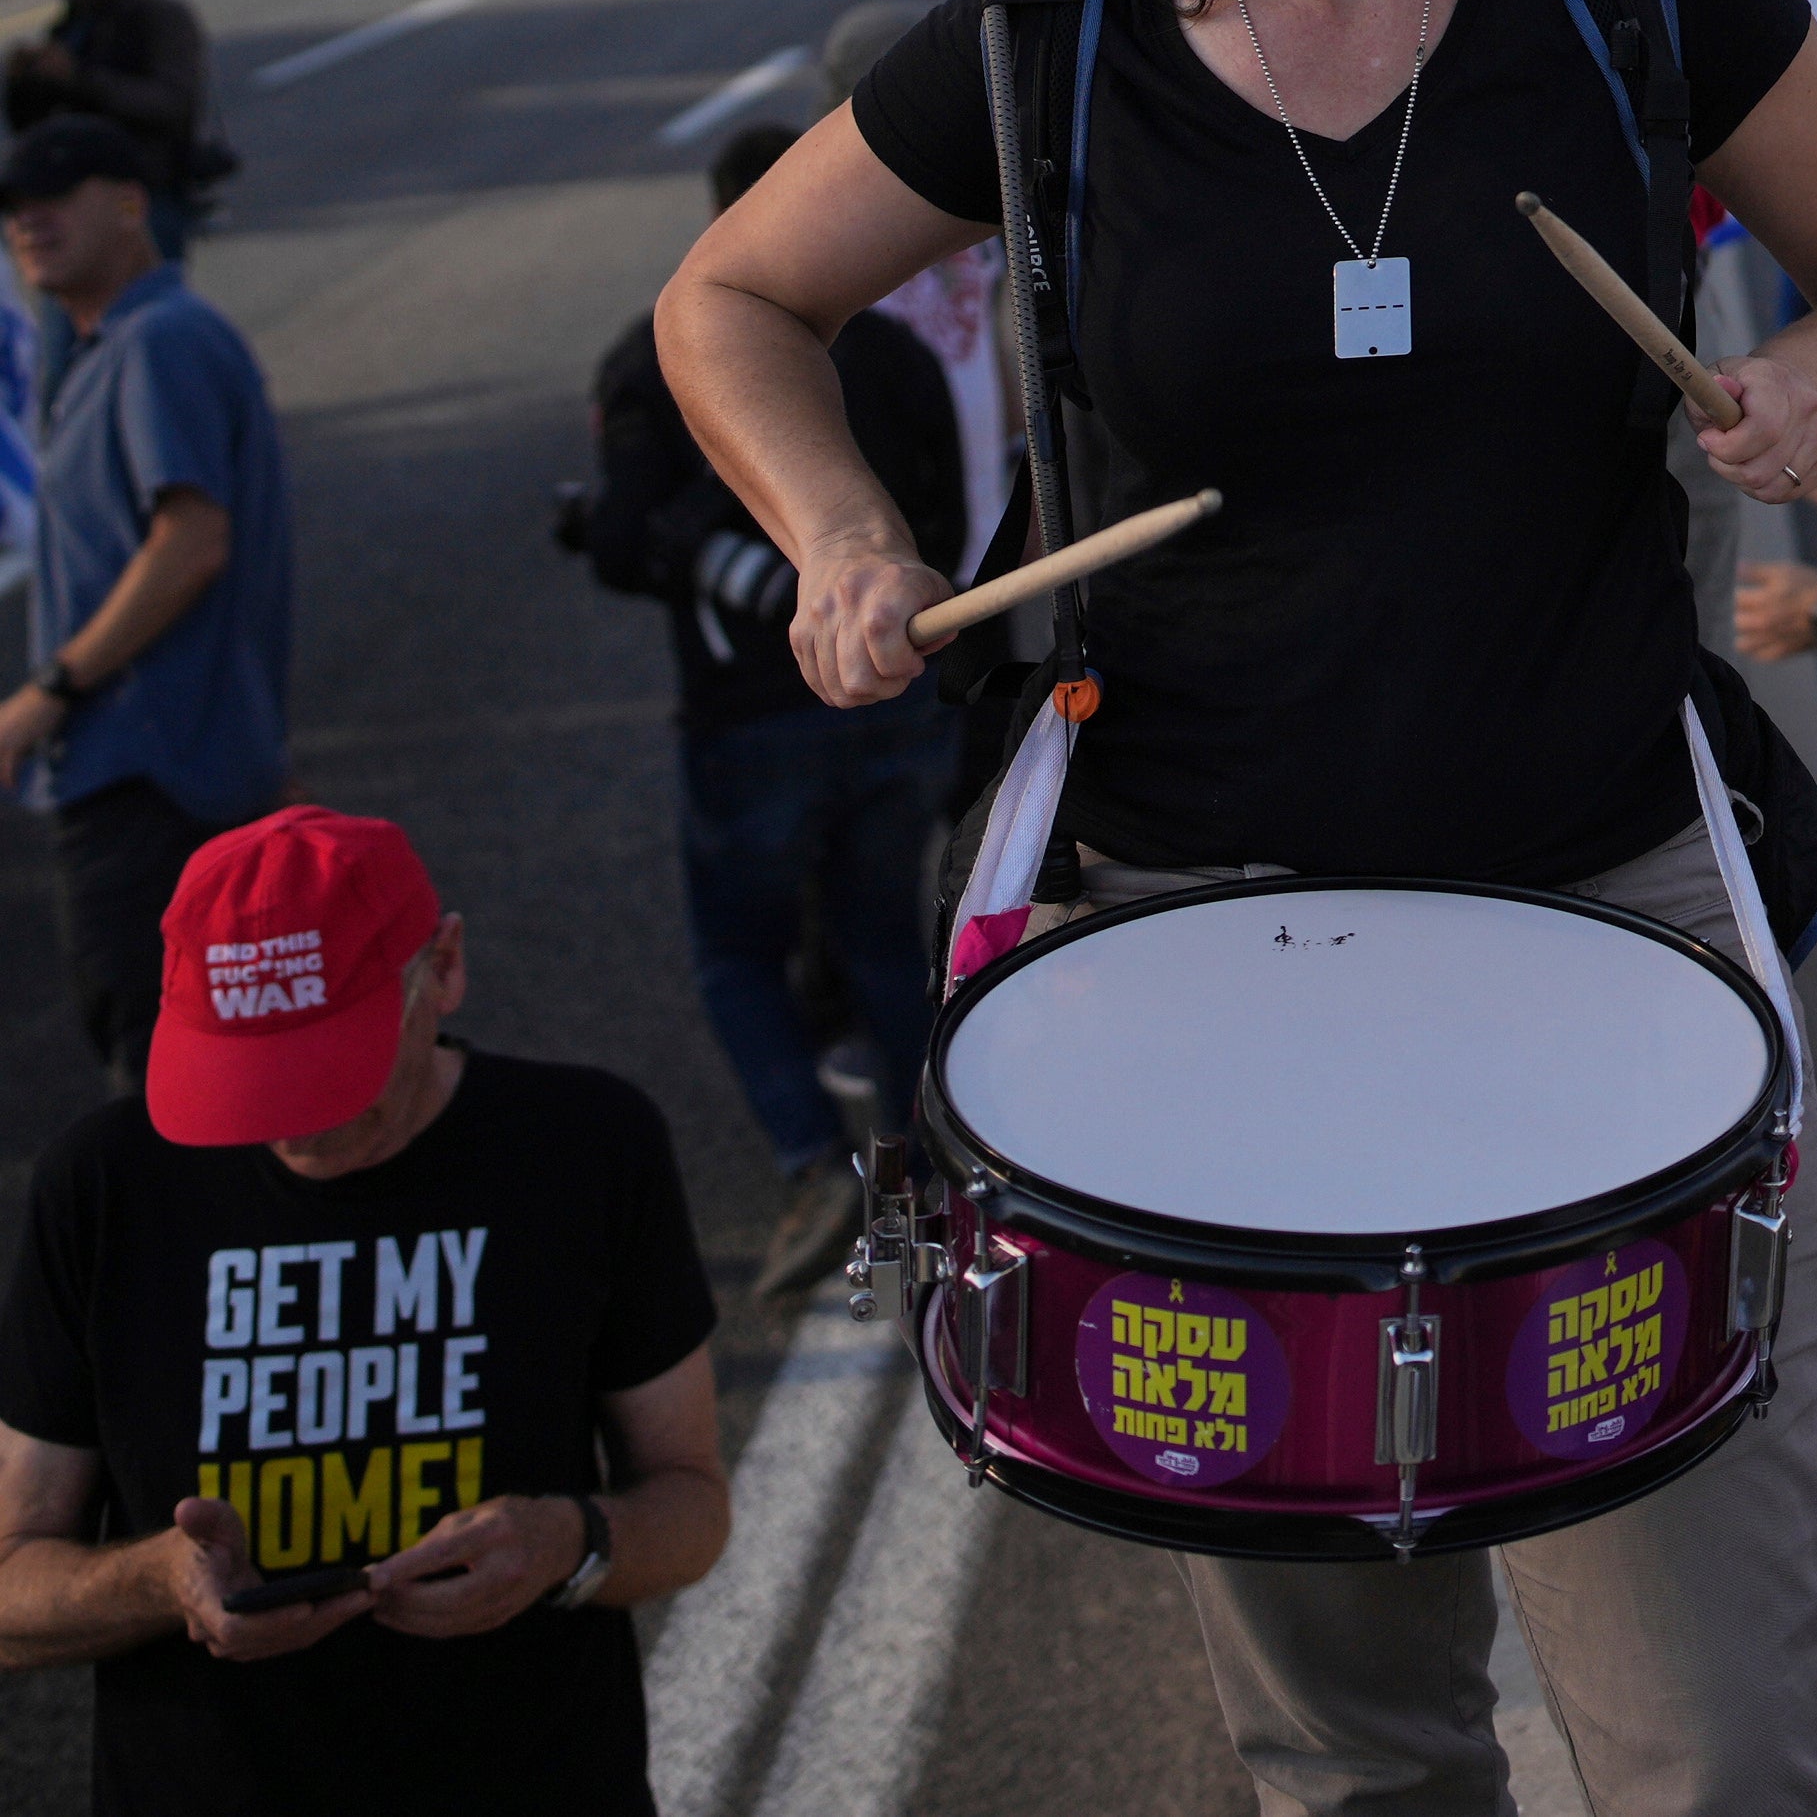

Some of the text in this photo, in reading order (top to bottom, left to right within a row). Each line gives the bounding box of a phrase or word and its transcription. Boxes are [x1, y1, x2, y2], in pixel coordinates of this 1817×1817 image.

[205, 929, 322, 964] END THIS
[211, 976, 328, 1020] WAR
[205, 1227, 489, 1349] GET MY
[1549, 1261, 1664, 1345] עסקה
[1112, 1299, 1247, 1362] עסקה
[1547, 1312, 1662, 1399] מלאה
[198, 1334, 488, 1454] PEOPLE
[1112, 1353, 1247, 1417] מלאה
[1546, 1384, 1617, 1434] פחות
[1621, 1362, 1661, 1407] ולא
[1112, 1404, 1248, 1453] ולא פחות
